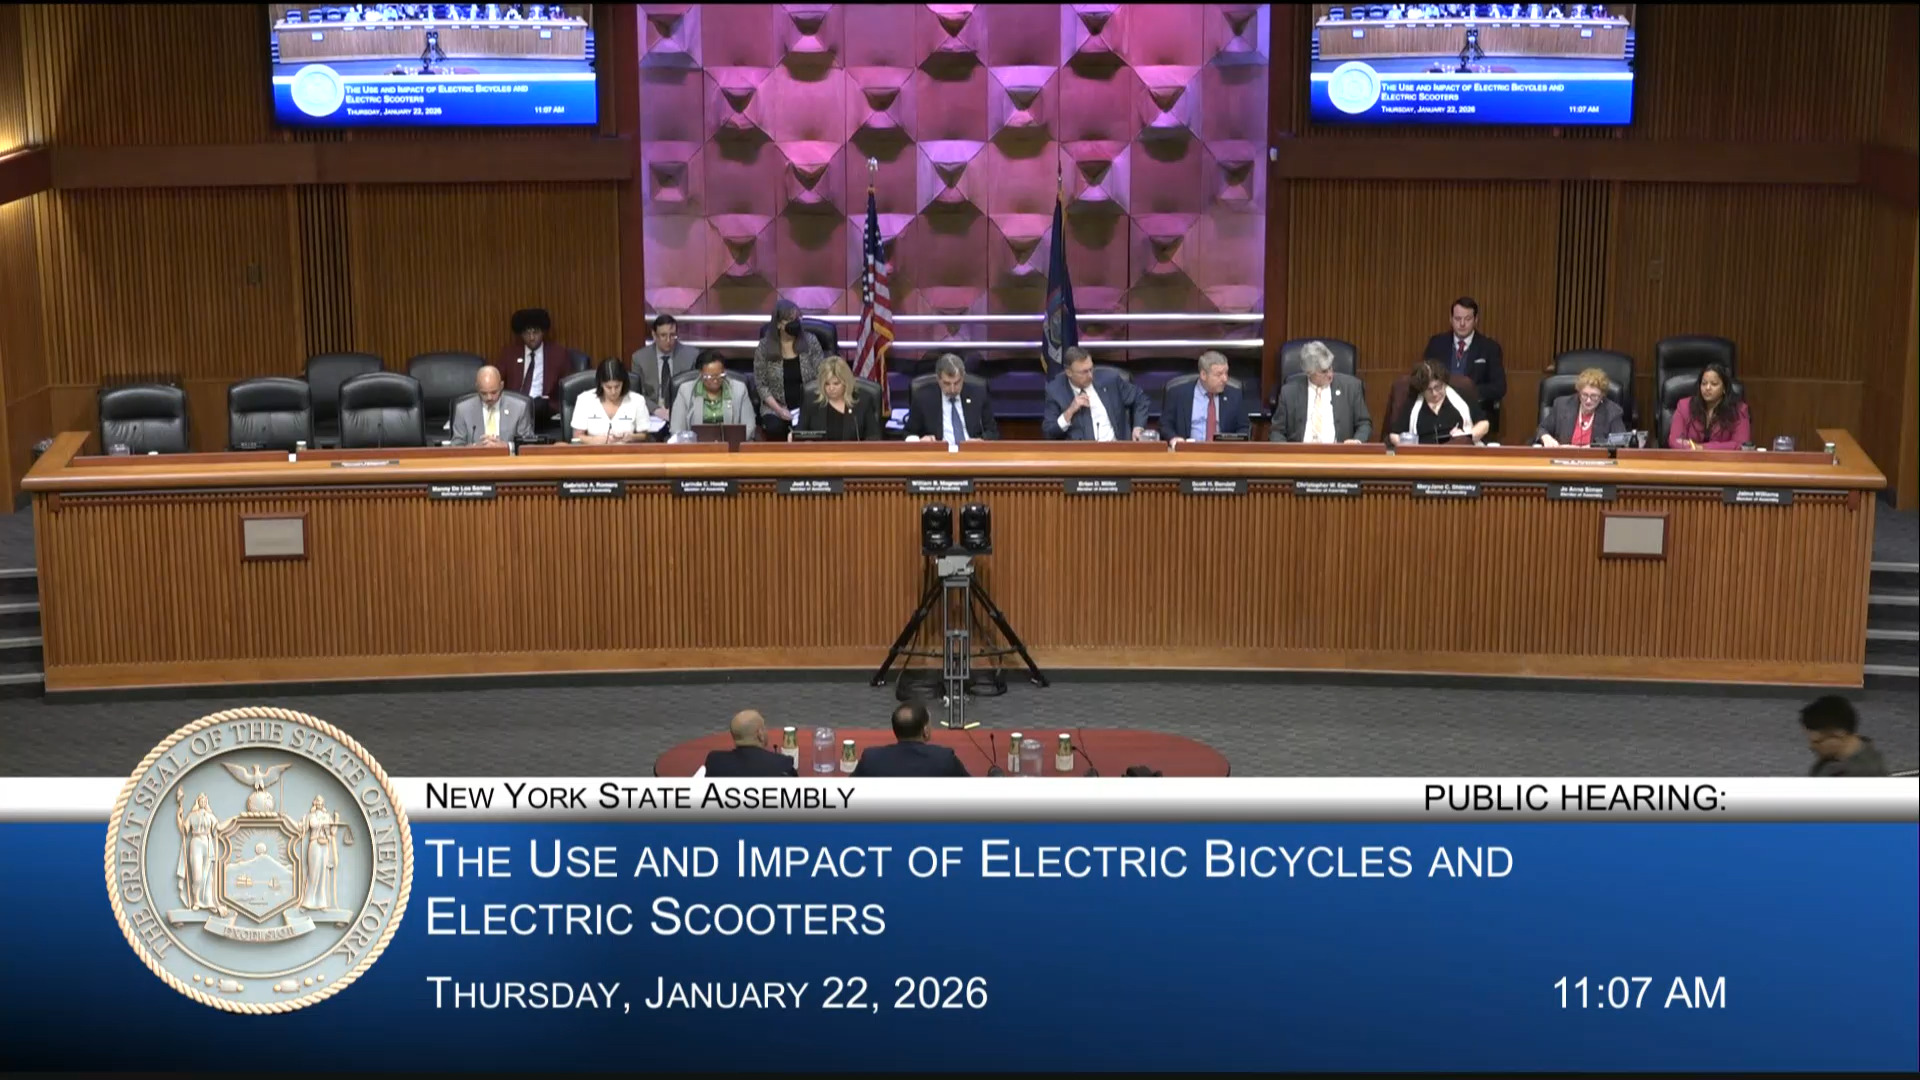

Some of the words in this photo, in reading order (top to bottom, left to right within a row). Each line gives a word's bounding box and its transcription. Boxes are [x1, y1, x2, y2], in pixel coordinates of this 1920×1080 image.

[438, 85, 474, 93] ELECTRIC
[476, 84, 511, 92] BICYCLES
[1474, 83, 1510, 91] ELECTRIC
[1512, 83, 1547, 91] BICYCLES
